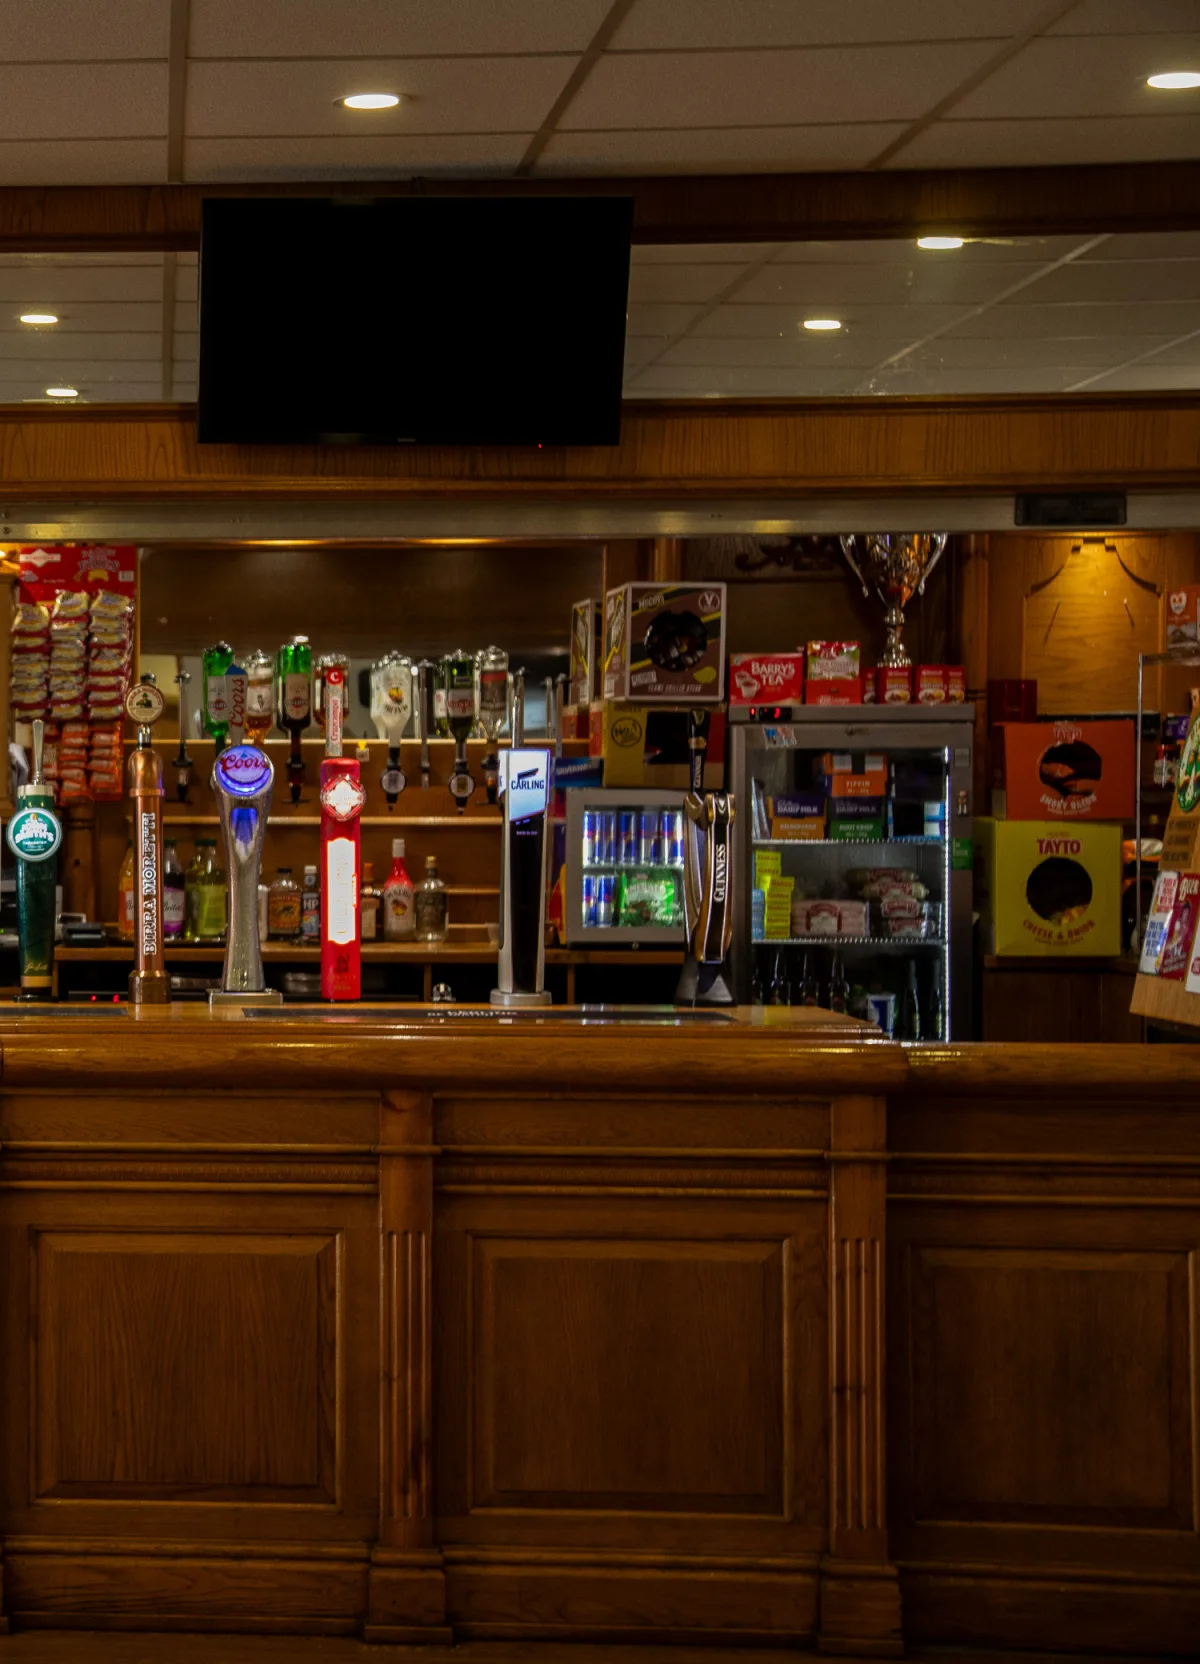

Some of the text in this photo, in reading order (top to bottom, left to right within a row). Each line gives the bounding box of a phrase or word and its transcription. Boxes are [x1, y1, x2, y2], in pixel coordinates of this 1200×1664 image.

[330, 671, 339, 682] C
[761, 675, 784, 686] TEA
[230, 678, 245, 728] Coors
[330, 699, 339, 741] Cruzcampo
[219, 754, 269, 771] Coors
[693, 755, 702, 788] GUINNESS
[511, 779, 544, 790] CARLING
[1037, 839, 1081, 854] TAYTO
[713, 843, 726, 902] GUINNESS
[142, 812, 157, 955] BIRRA MORETTI
[303, 899, 319, 910] HP
